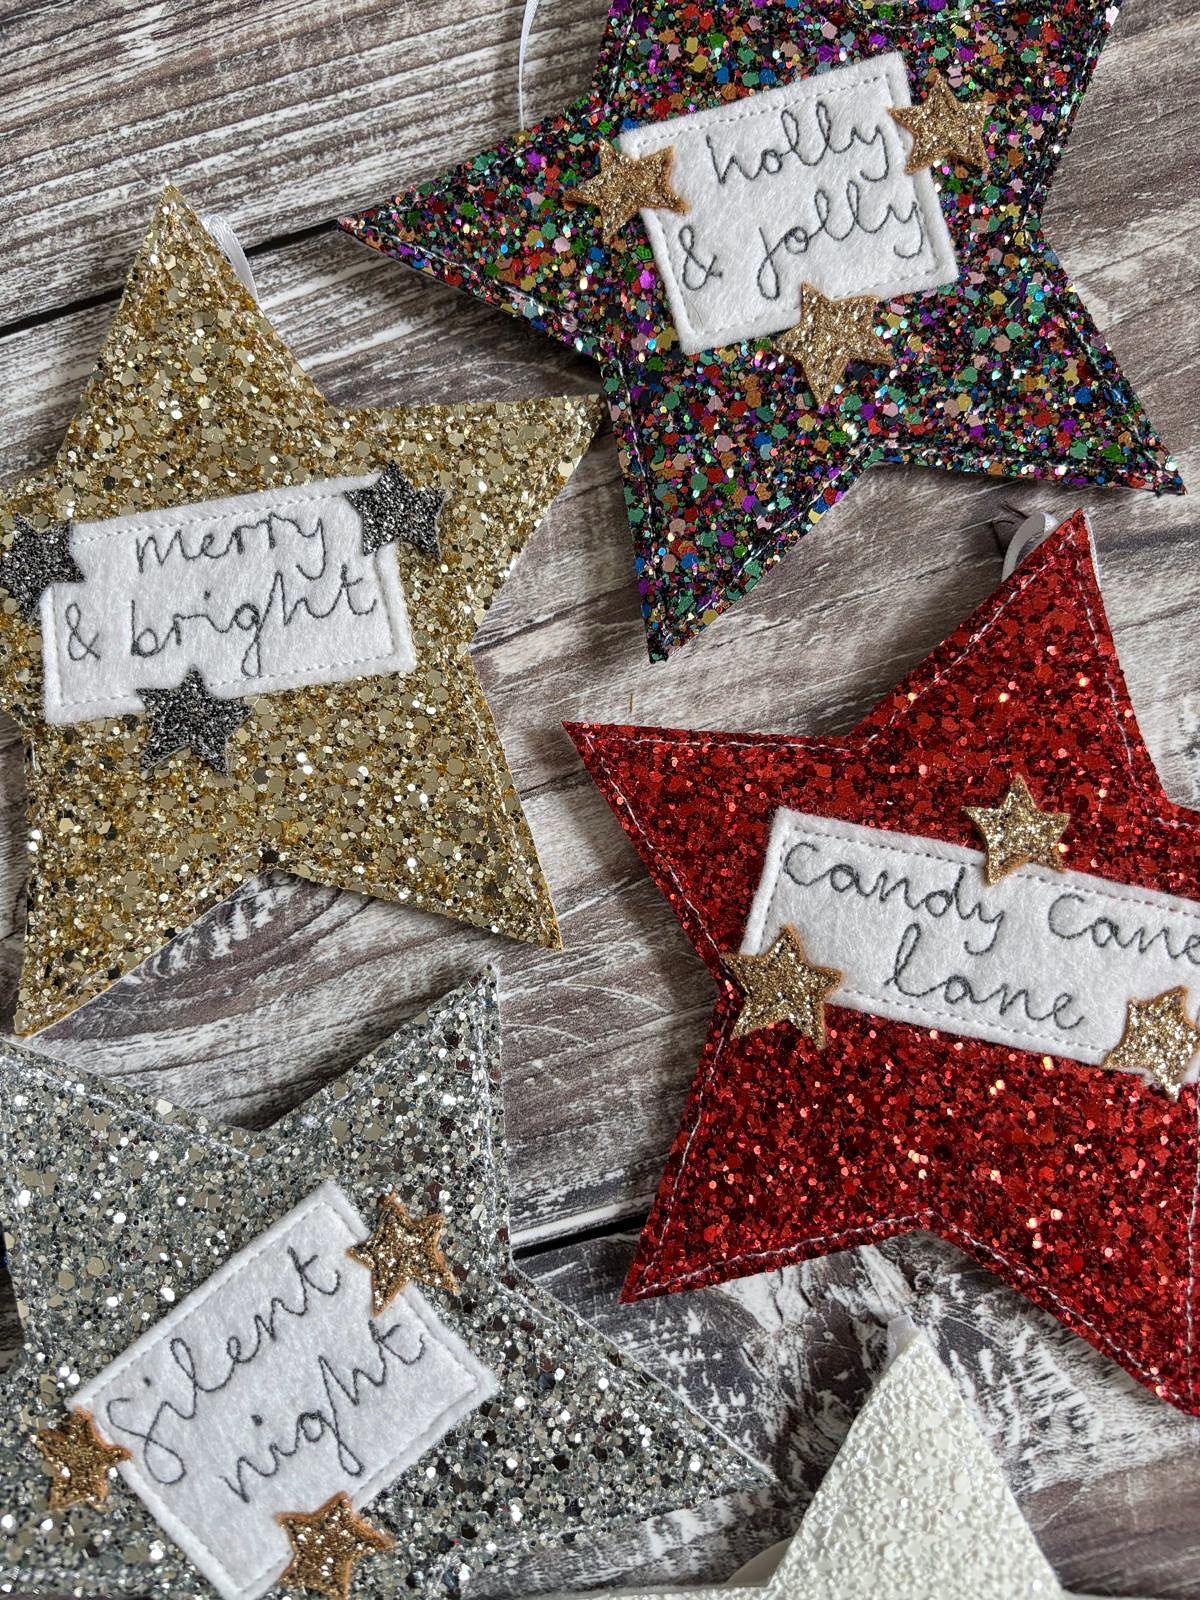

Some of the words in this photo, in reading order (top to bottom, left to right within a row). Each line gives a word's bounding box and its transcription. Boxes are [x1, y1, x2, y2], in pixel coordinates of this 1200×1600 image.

[706, 101, 890, 185] holly
[678, 225, 722, 291] &
[757, 180, 925, 300] jolly
[135, 512, 327, 582] merry
[64, 602, 101, 662] &
[130, 564, 378, 678] bright
[219, 1319, 427, 1504] night
